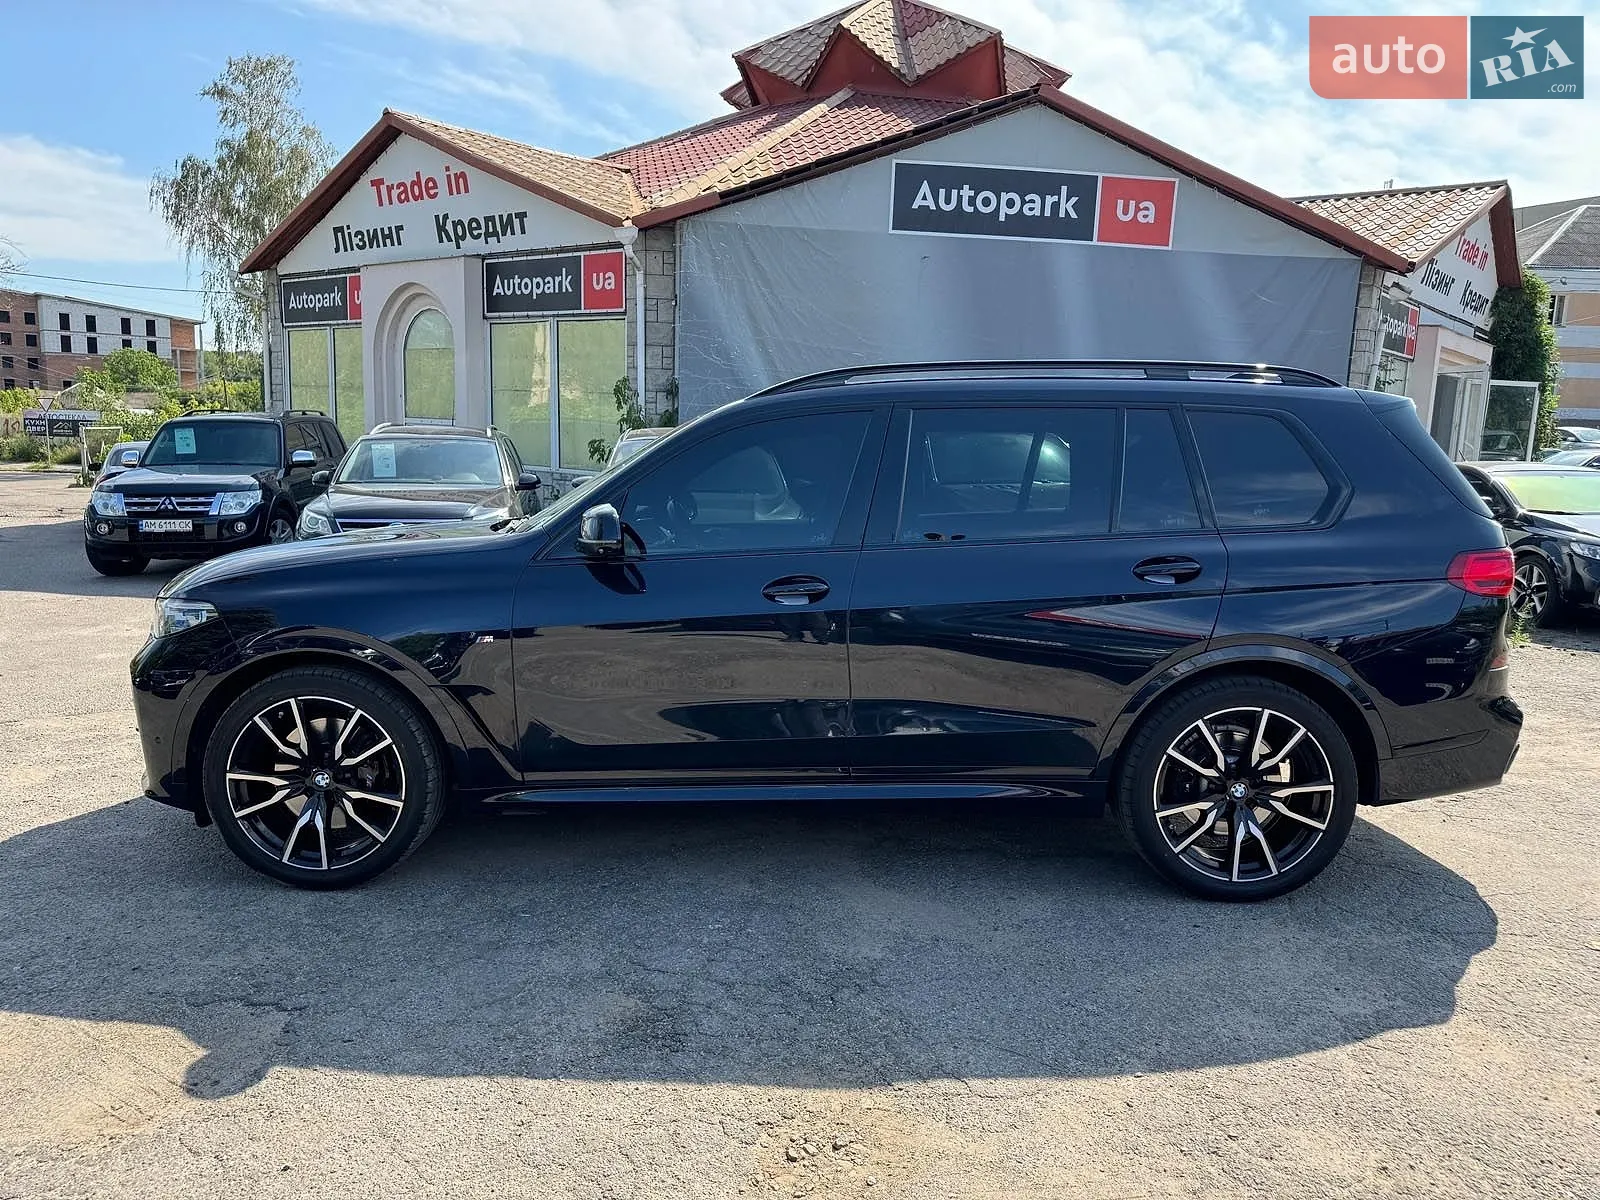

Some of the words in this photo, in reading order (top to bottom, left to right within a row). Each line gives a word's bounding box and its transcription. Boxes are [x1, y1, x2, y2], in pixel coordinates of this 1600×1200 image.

[370, 171, 439, 207] Trade
[445, 165, 470, 196] in
[912, 179, 1080, 222] Autopark
[1115, 198, 1156, 224] ua
[332, 224, 404, 254] Лізинг
[434, 211, 528, 249] Кредит
[1478, 243, 1489, 272] in
[289, 286, 342, 312] Autopark
[354, 289, 362, 305] u
[493, 267, 573, 299] Autopark
[592, 270, 616, 291] ua
[1420, 257, 1456, 296] Лізинг
[1460, 279, 1490, 317] Кредит
[144, 520, 157, 529] AM
[158, 520, 177, 529] 6111
[178, 520, 192, 529] CK
